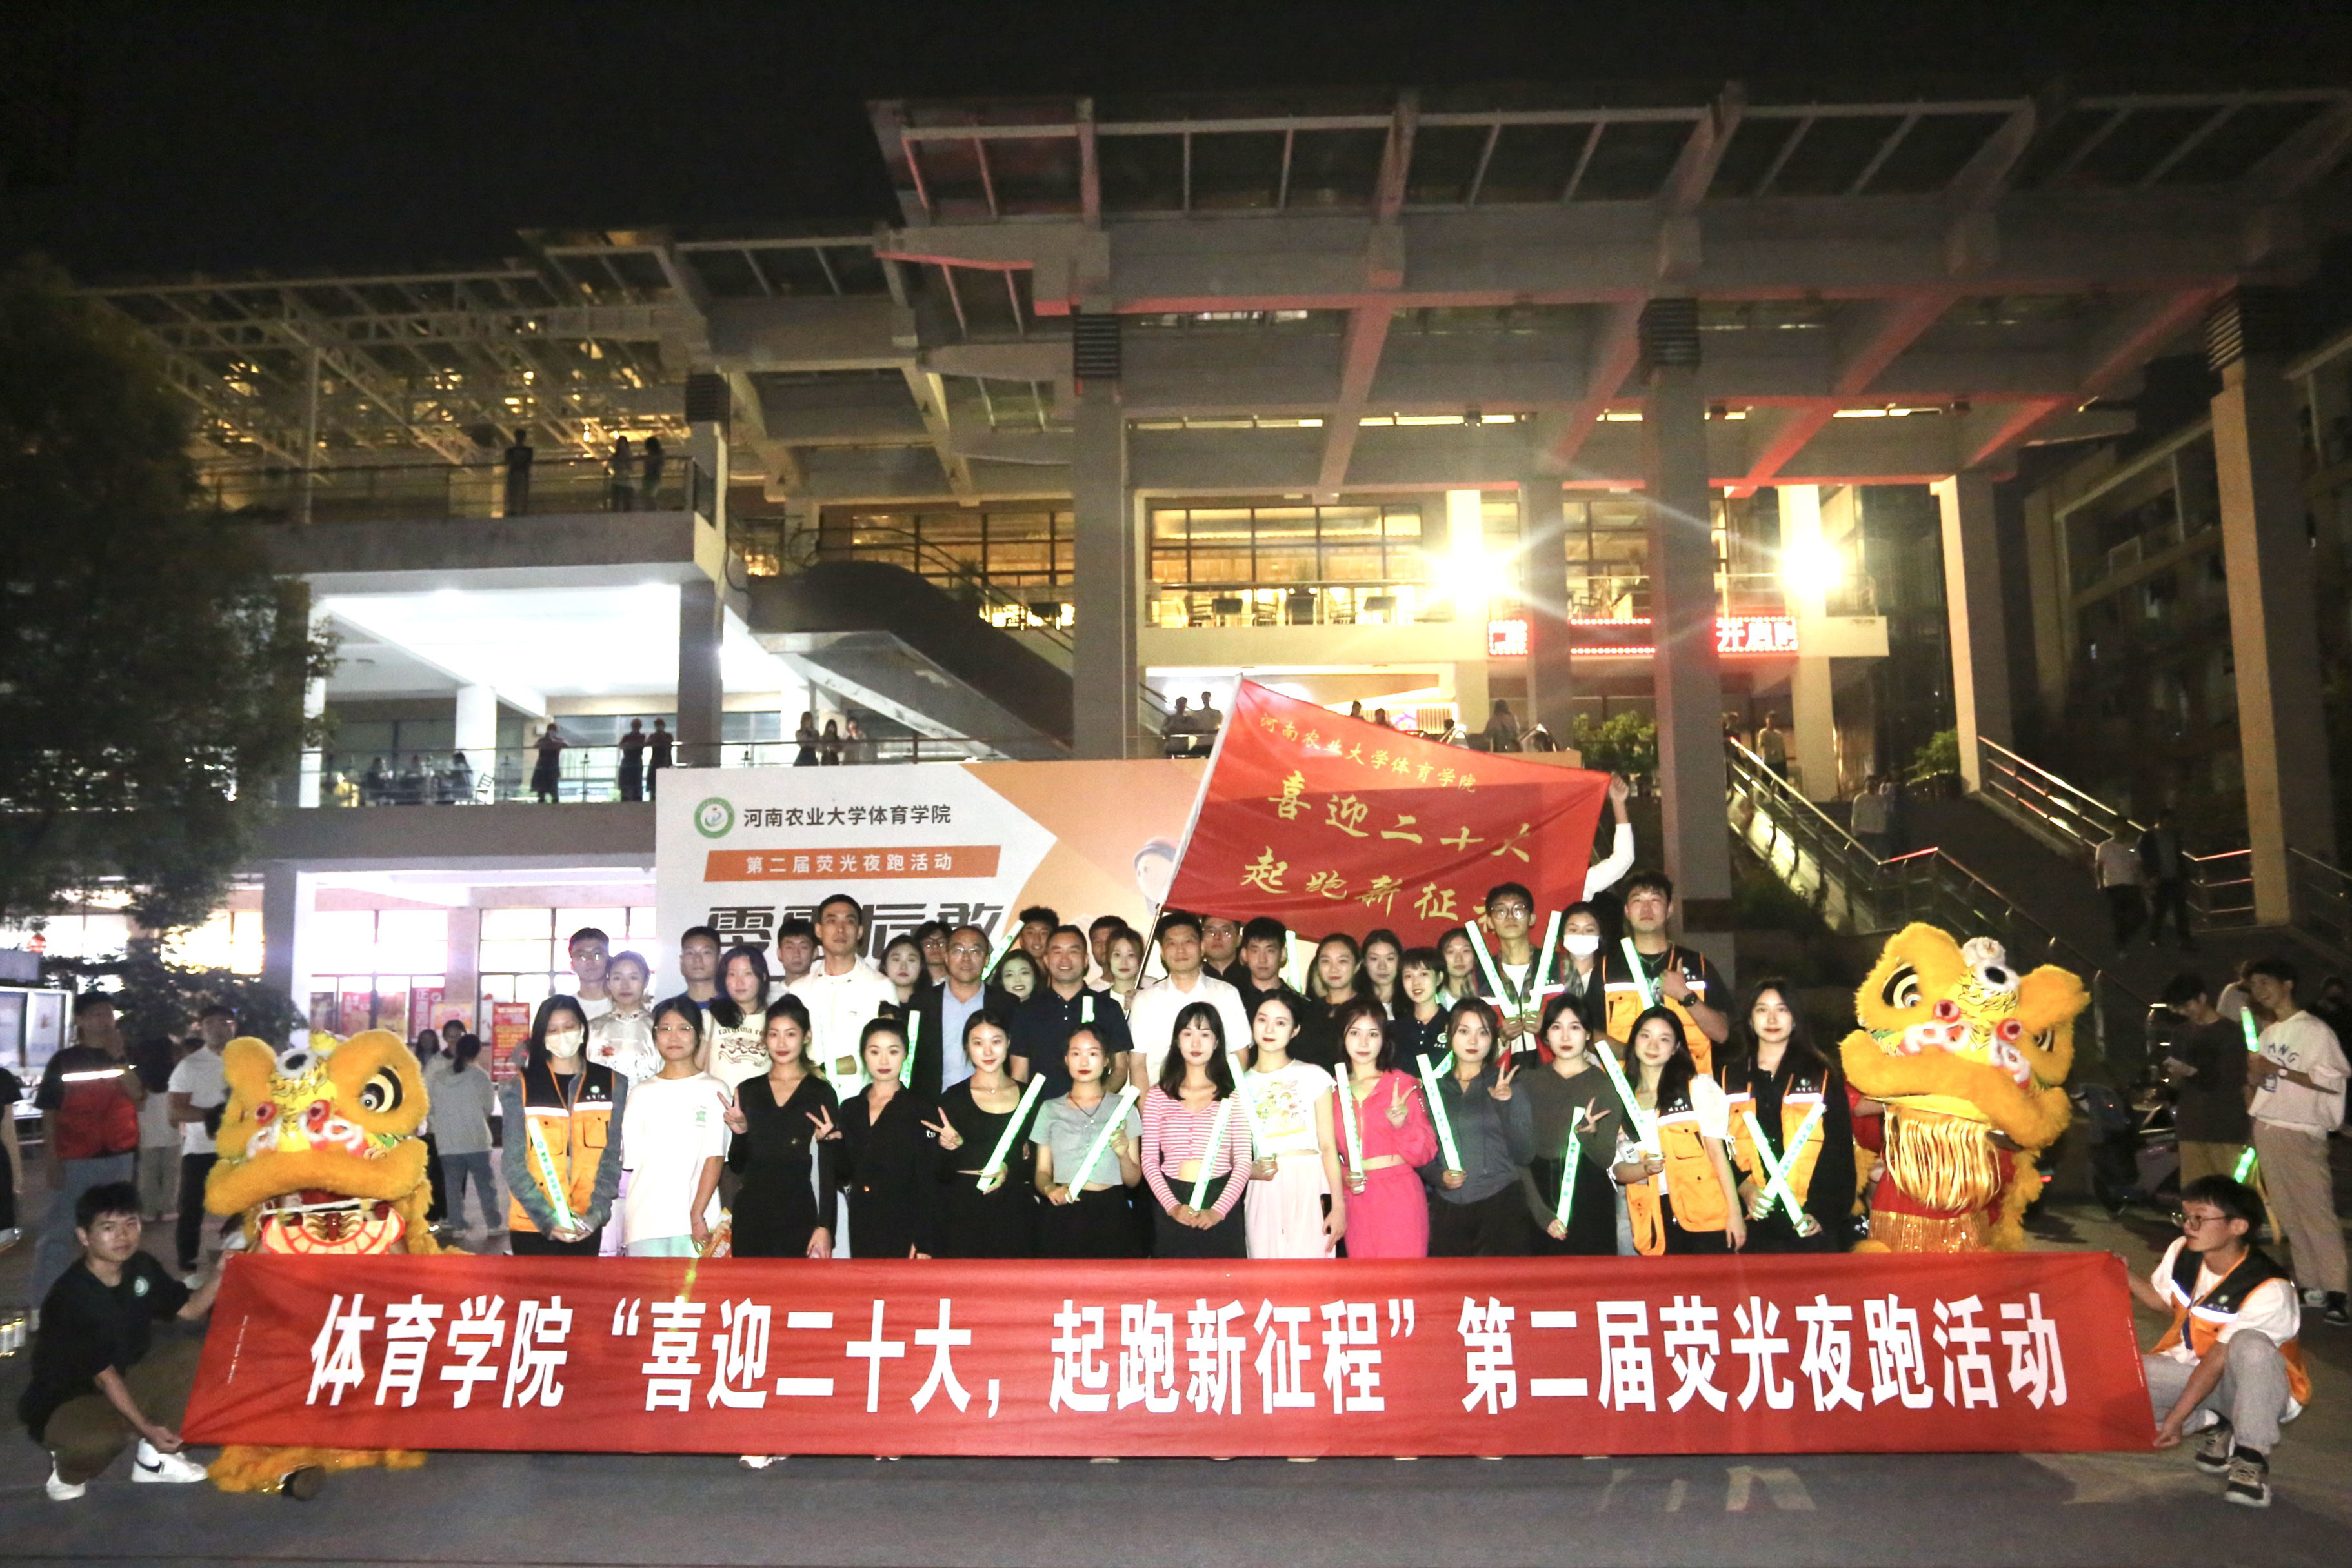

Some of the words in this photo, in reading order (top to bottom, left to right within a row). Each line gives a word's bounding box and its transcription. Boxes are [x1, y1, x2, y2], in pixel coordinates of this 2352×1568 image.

[1260, 713, 1476, 793] 河南农业大学体育学院
[743, 805, 951, 828] 河南农业大学体育学院
[1268, 770, 1529, 863] 喜迎二十大
[746, 853, 953, 874] 第二届荧光夜跑活动
[1240, 845, 1487, 933] 起跑新征
